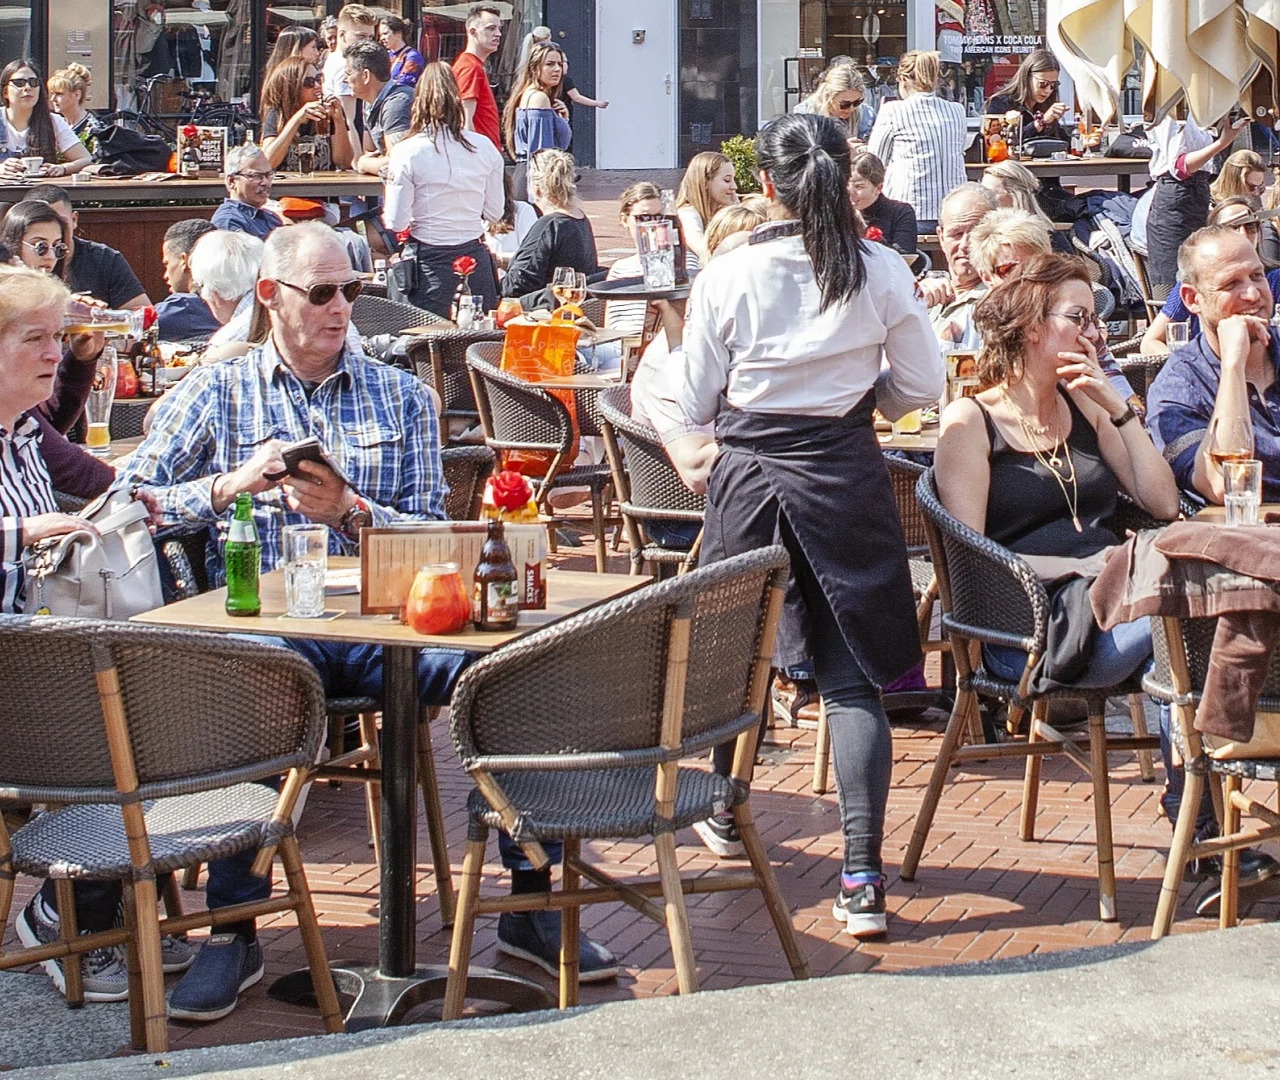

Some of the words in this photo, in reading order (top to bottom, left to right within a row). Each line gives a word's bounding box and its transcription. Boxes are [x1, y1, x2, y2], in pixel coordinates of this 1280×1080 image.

[996, 36, 1003, 45] X
[1003, 36, 1022, 45] COCA
[1024, 36, 1042, 45] COLA
[964, 46, 993, 54] AMERICAN
[526, 569, 534, 604] SNACKS
